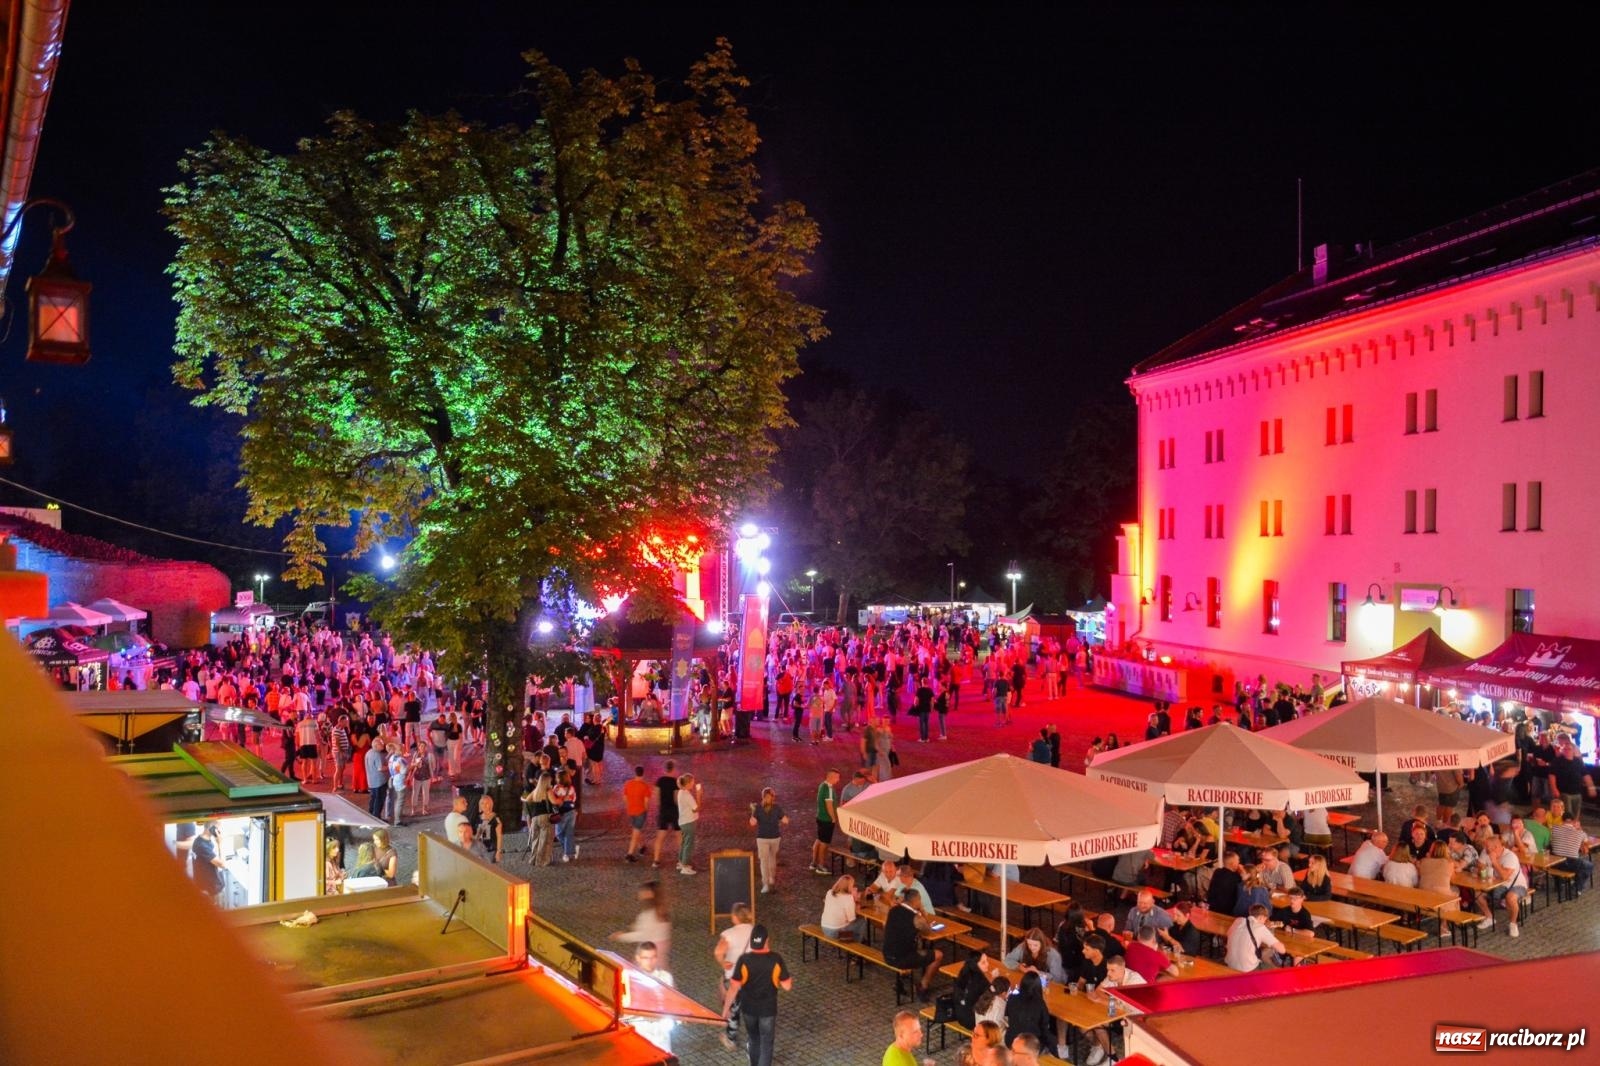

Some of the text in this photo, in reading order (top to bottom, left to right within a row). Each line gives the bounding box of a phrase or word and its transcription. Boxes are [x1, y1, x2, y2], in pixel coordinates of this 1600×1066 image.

[1465, 662, 1503, 675] Browar
[1499, 667, 1552, 683] Zamkowy
[1479, 682, 1534, 703] RACIBORSKIE
[1396, 753, 1459, 769] RACIBORSKIE
[1187, 787, 1263, 805] RACIBORSKIE
[1304, 786, 1352, 805] RACIBORSKIE
[849, 817, 890, 848] RACIBORSKIE
[931, 839, 1018, 861] RACIBORSKIE
[1070, 832, 1138, 859] RACIBORSKIE
